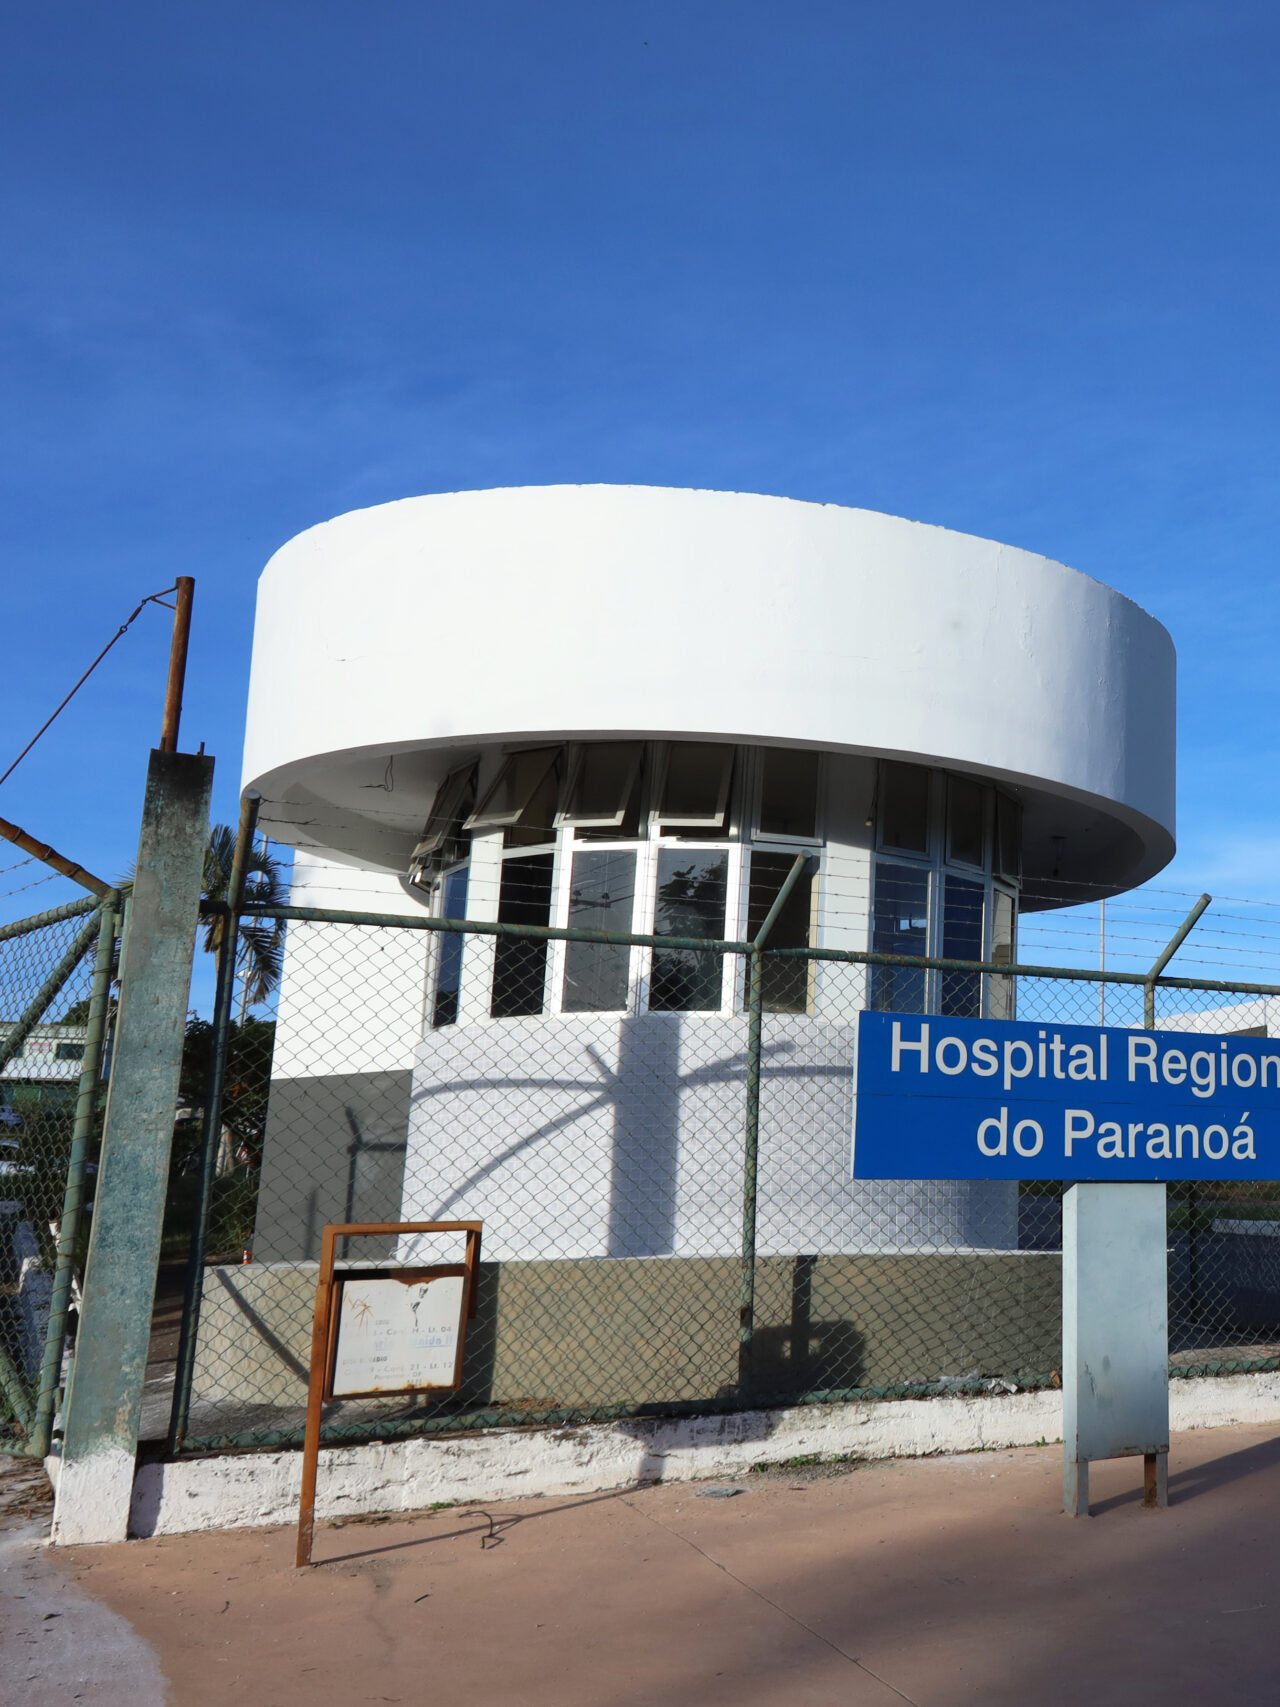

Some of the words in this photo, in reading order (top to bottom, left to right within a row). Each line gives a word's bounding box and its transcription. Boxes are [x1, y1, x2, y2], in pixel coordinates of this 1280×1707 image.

[890, 1021, 1108, 1091] Hospital
[976, 1106, 1044, 1158] do
[1064, 1109, 1257, 1160] Paranoá
